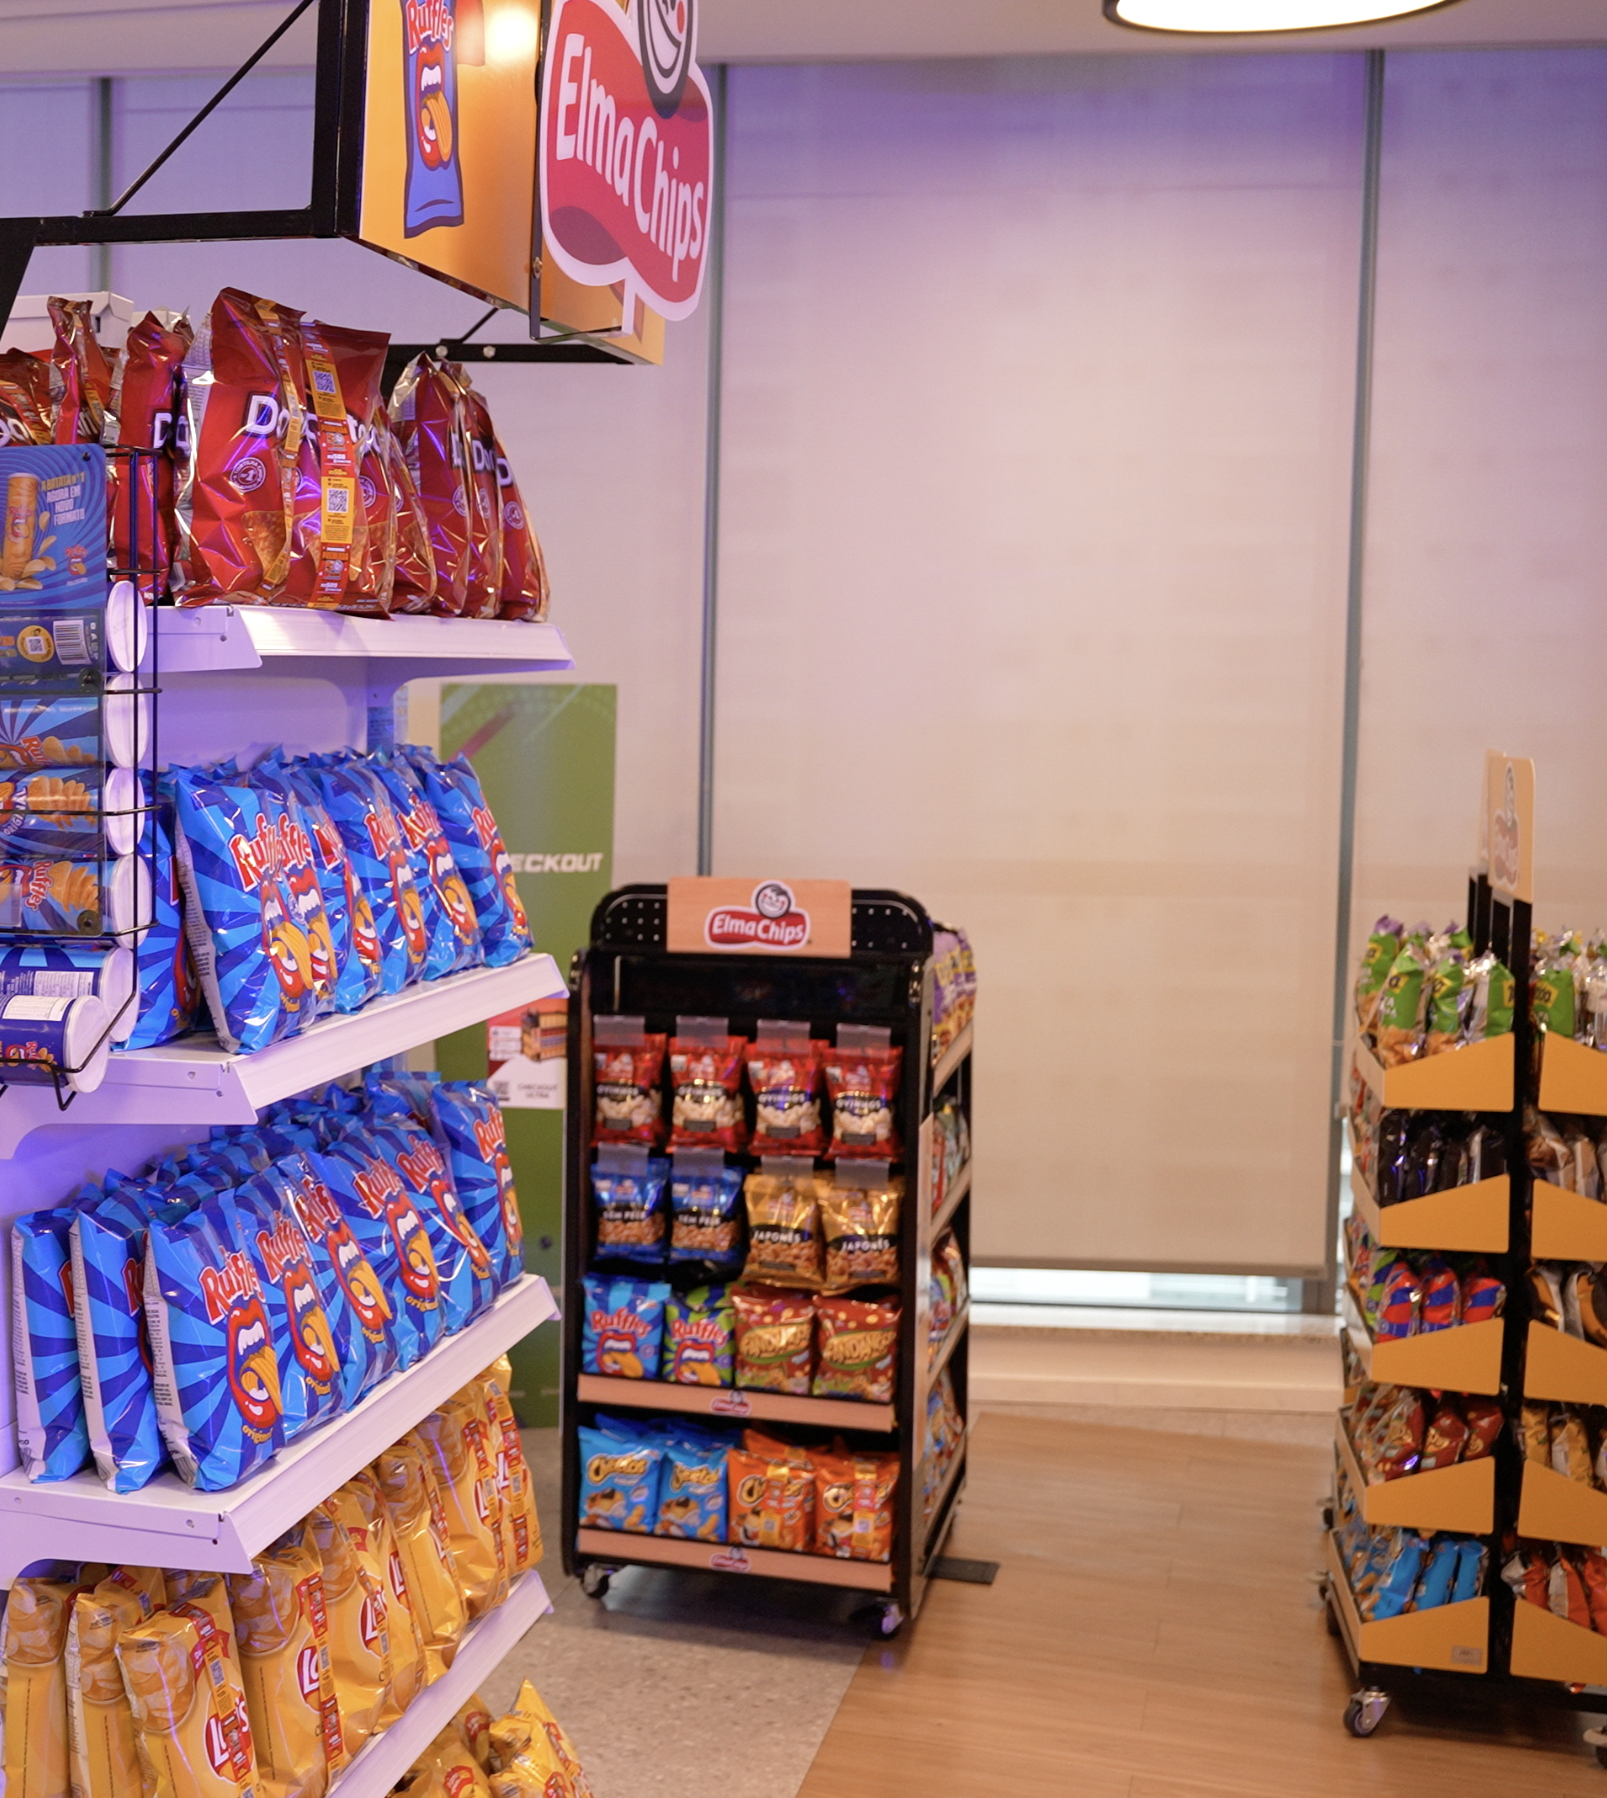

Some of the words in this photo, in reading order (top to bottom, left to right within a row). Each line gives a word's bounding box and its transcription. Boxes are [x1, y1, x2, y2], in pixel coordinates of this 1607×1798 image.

[407, 0, 455, 55] Ruffles
[46, 487, 70, 504] AGORA
[70, 485, 81, 498] EM
[54, 508, 85, 527] FORMATO
[510, 852, 604, 873] ECKOUT
[25, 860, 56, 911] Ruffles
[591, 1308, 653, 1338] Ruffles
[670, 1317, 730, 1348] Ruffles
